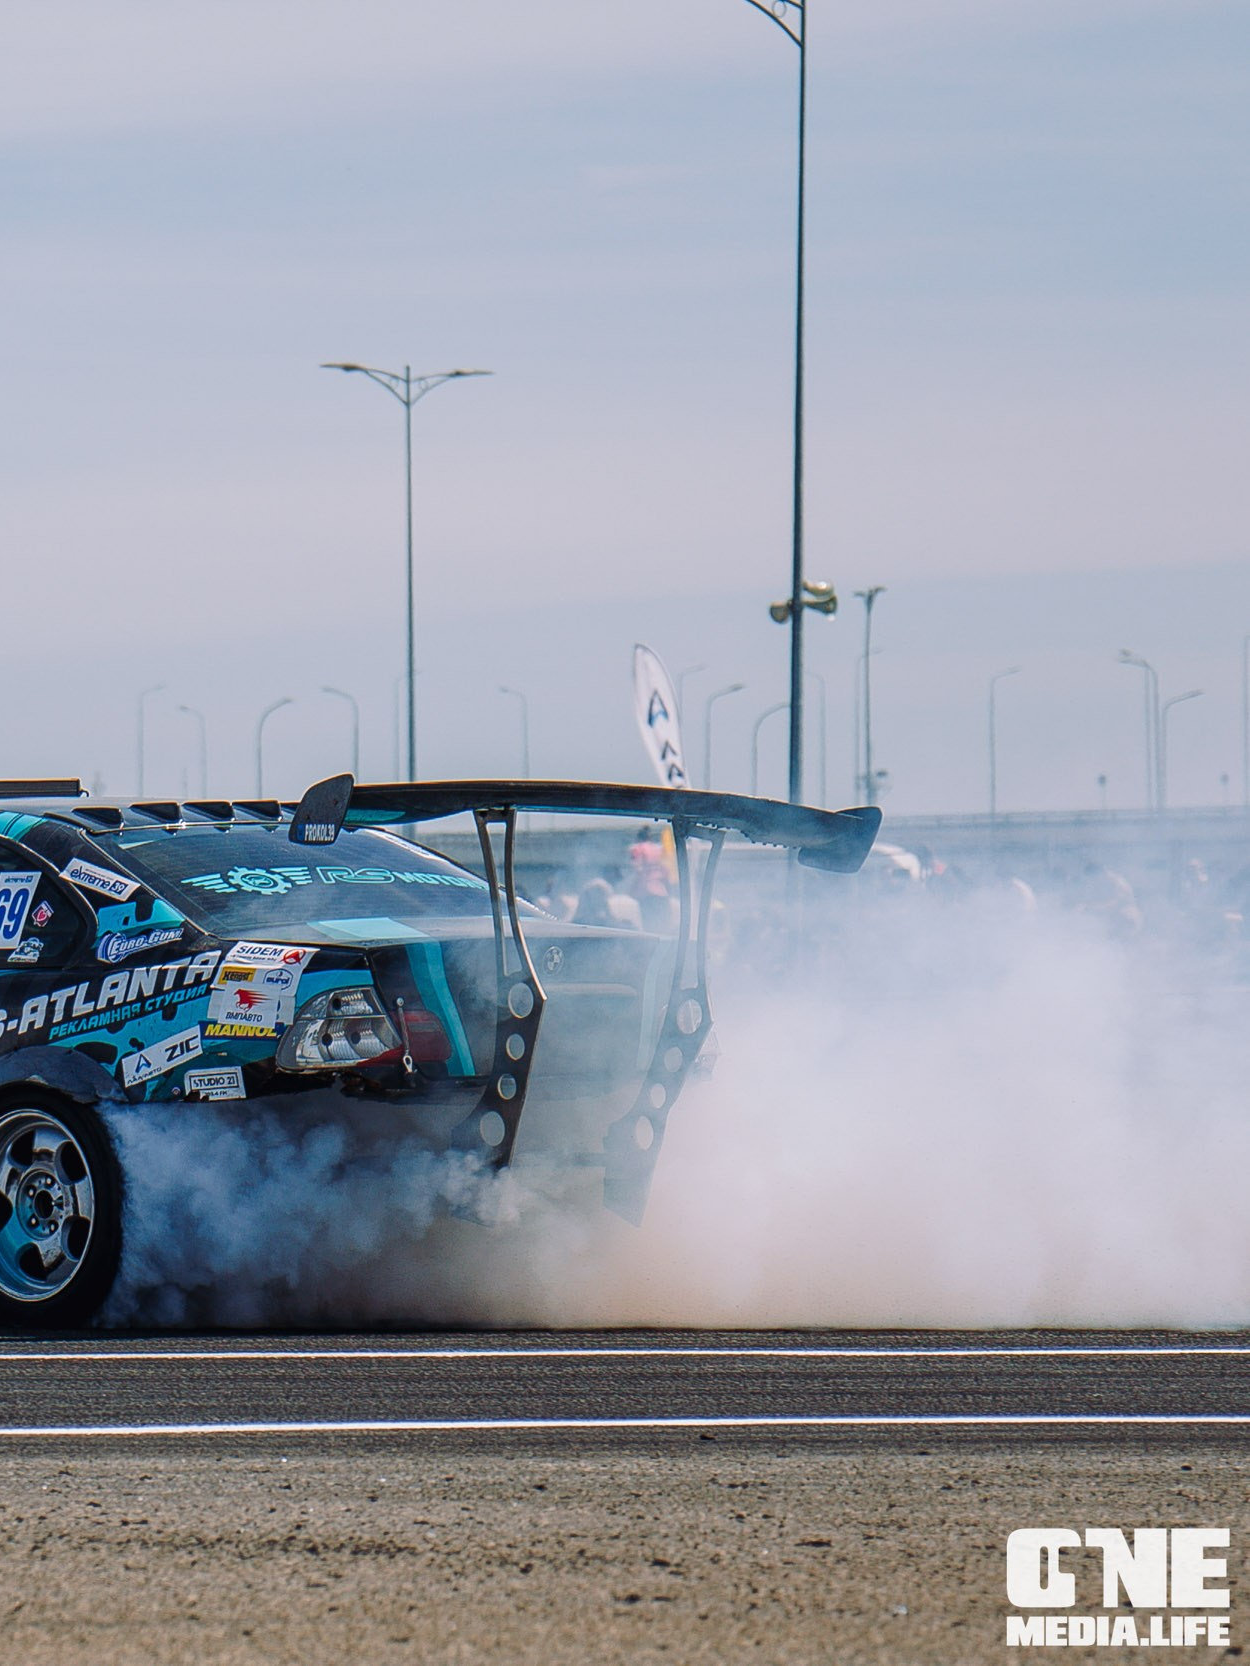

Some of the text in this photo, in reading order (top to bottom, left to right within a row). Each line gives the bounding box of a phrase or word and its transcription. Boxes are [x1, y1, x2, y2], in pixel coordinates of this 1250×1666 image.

[305, 823, 335, 842] PROKOL39
[237, 945, 284, 957] SIDEM
[49, 983, 208, 1040] РЕКЛАМНАЯ СТУДИЯ
[225, 1011, 263, 1022] ВМПАВТО
[205, 1023, 277, 1038] MANNOL
[165, 1035, 199, 1062] ZIC
[193, 1075, 236, 1088] STUDIO 21
